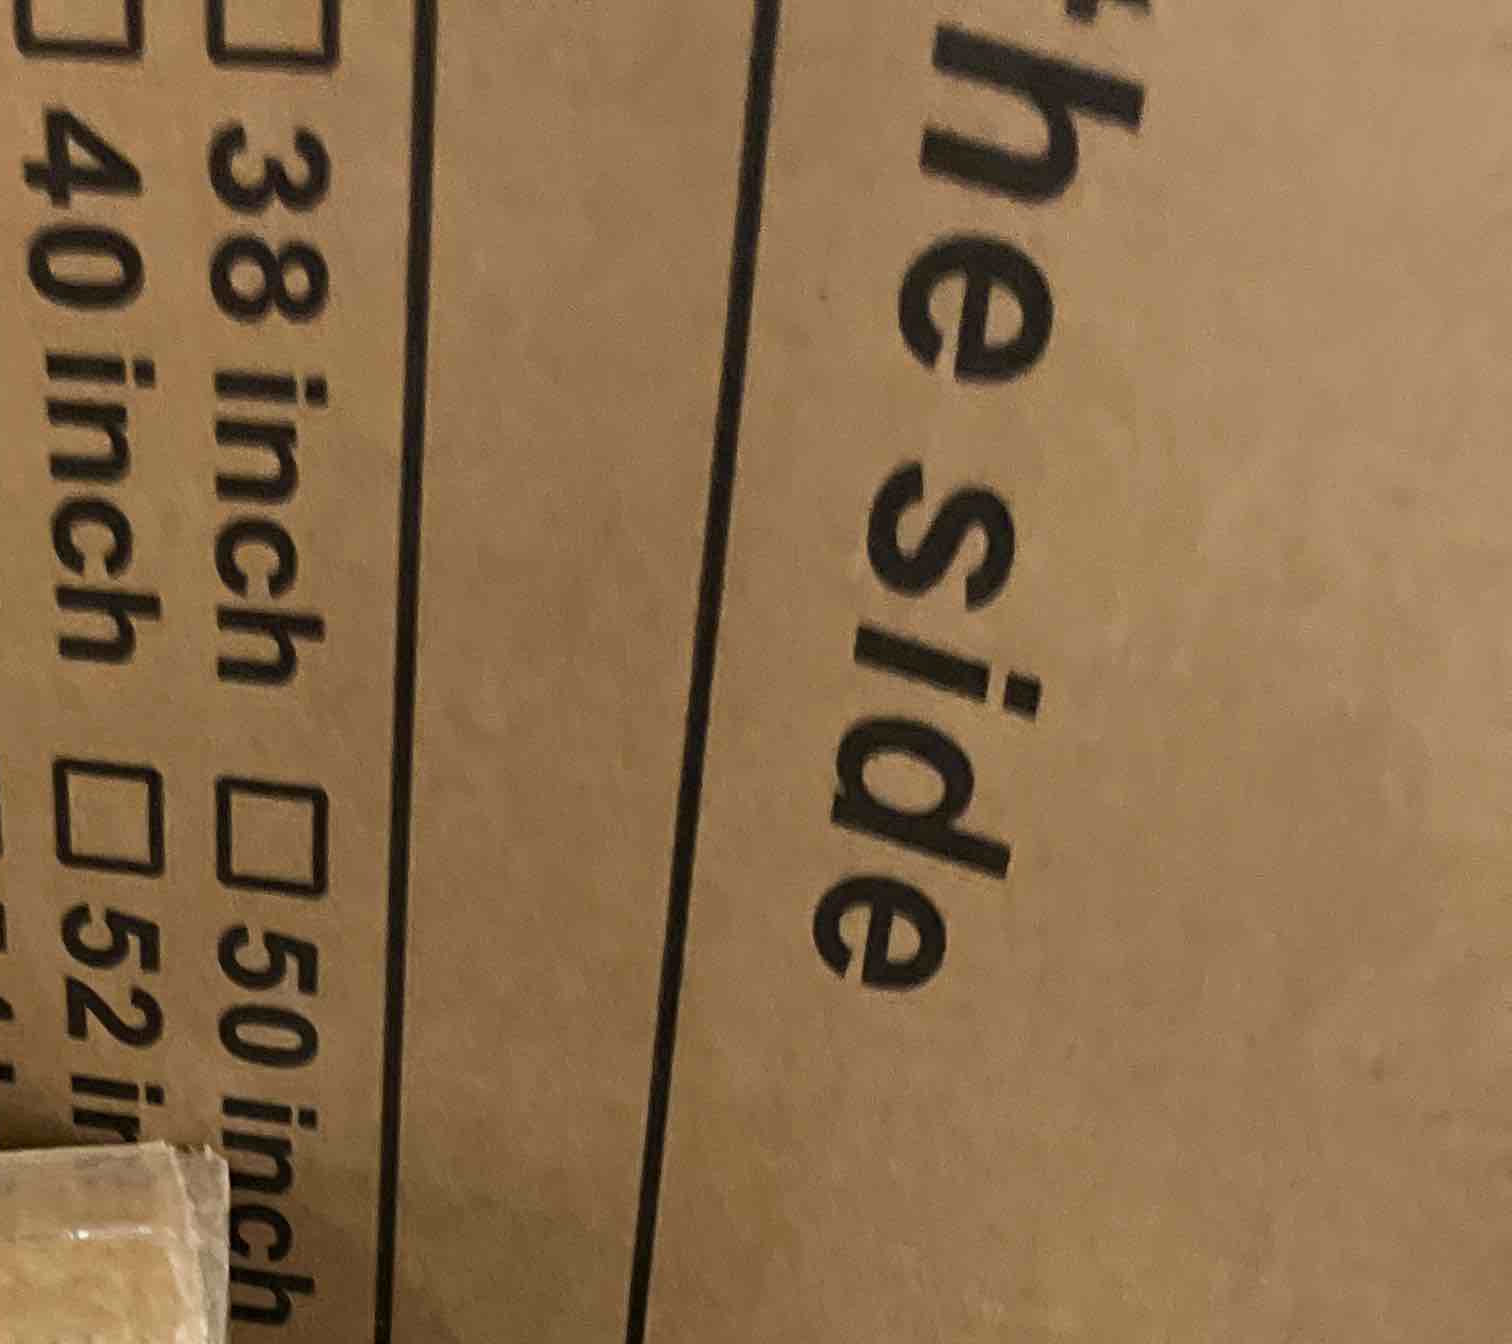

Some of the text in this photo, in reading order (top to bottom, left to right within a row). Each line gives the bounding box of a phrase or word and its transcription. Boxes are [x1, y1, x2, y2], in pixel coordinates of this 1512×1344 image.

[22, 103, 162, 665] 40 inch
[207, 118, 331, 687] 38 inch
[59, 902, 164, 1049] 52
[811, 458, 1043, 992] side
[217, 922, 320, 1328] 50 inch
